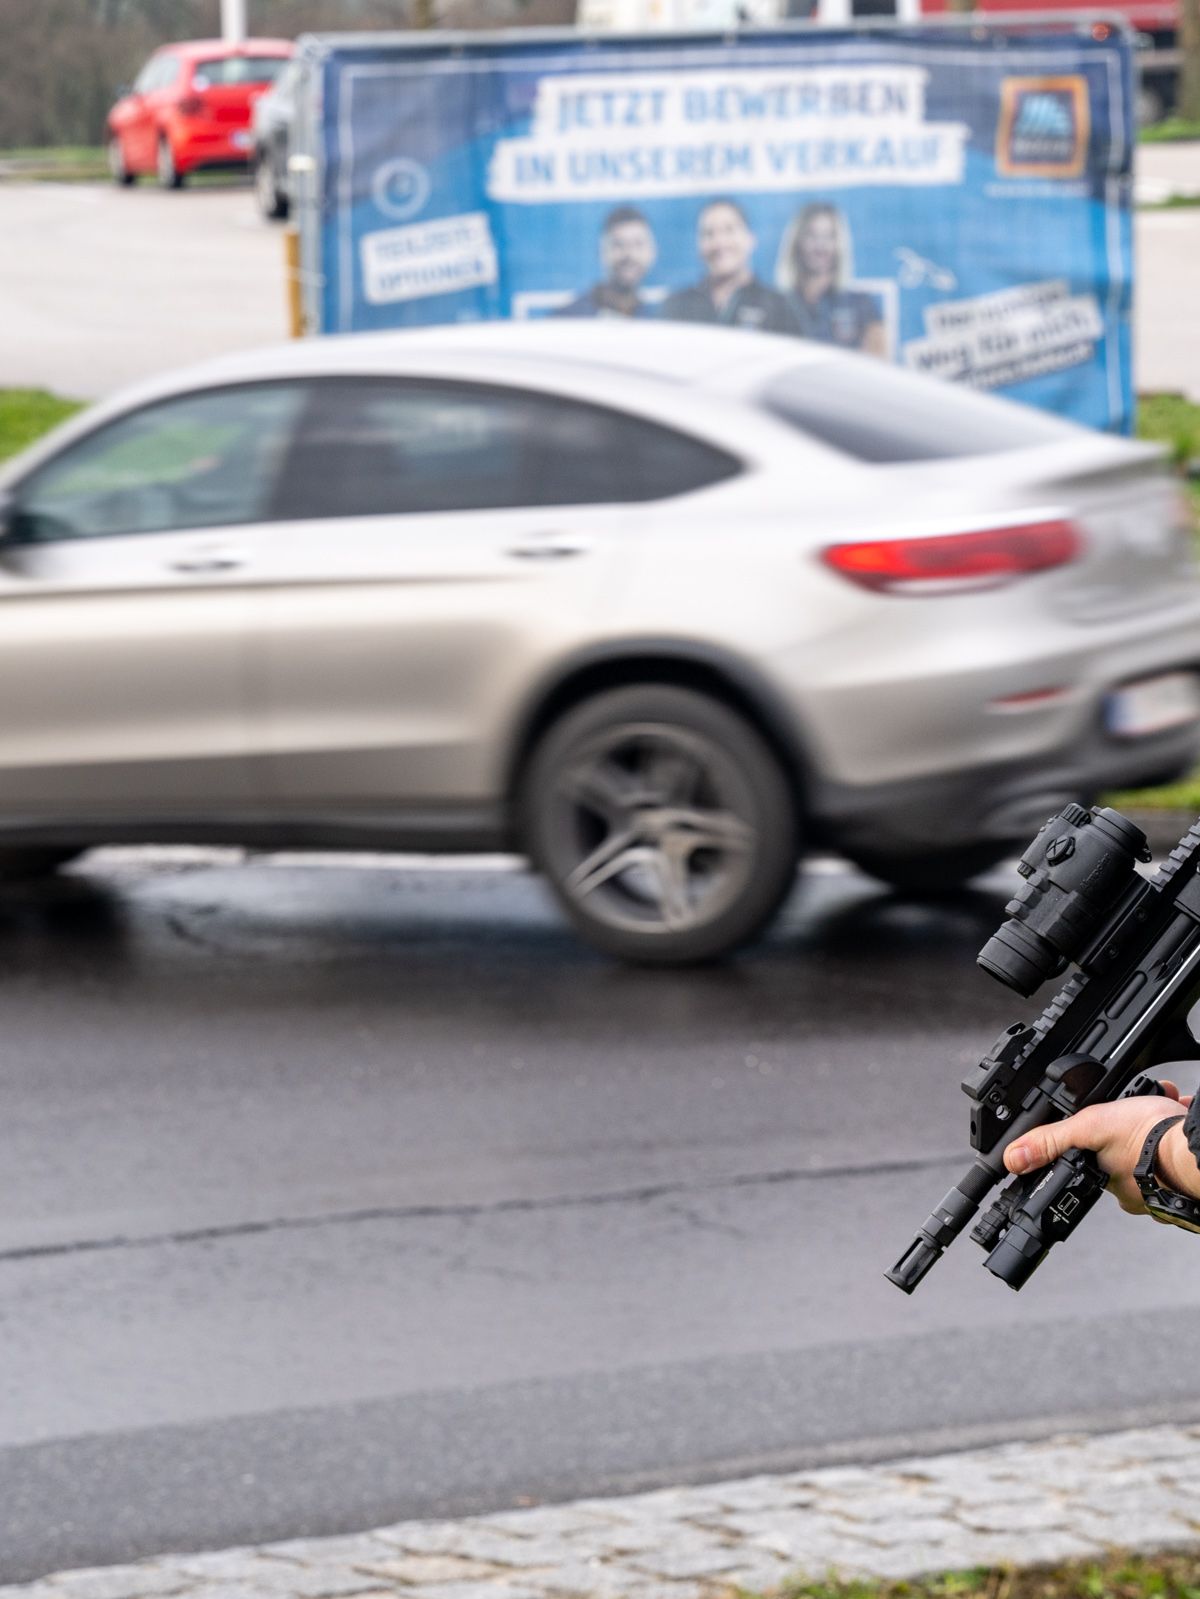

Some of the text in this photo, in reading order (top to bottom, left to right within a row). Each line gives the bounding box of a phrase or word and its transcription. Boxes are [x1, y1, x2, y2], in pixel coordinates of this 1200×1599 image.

[558, 77, 909, 132] JETZT BEWERBEN
[514, 134, 942, 184] IN UNSEREM VERKAUF
